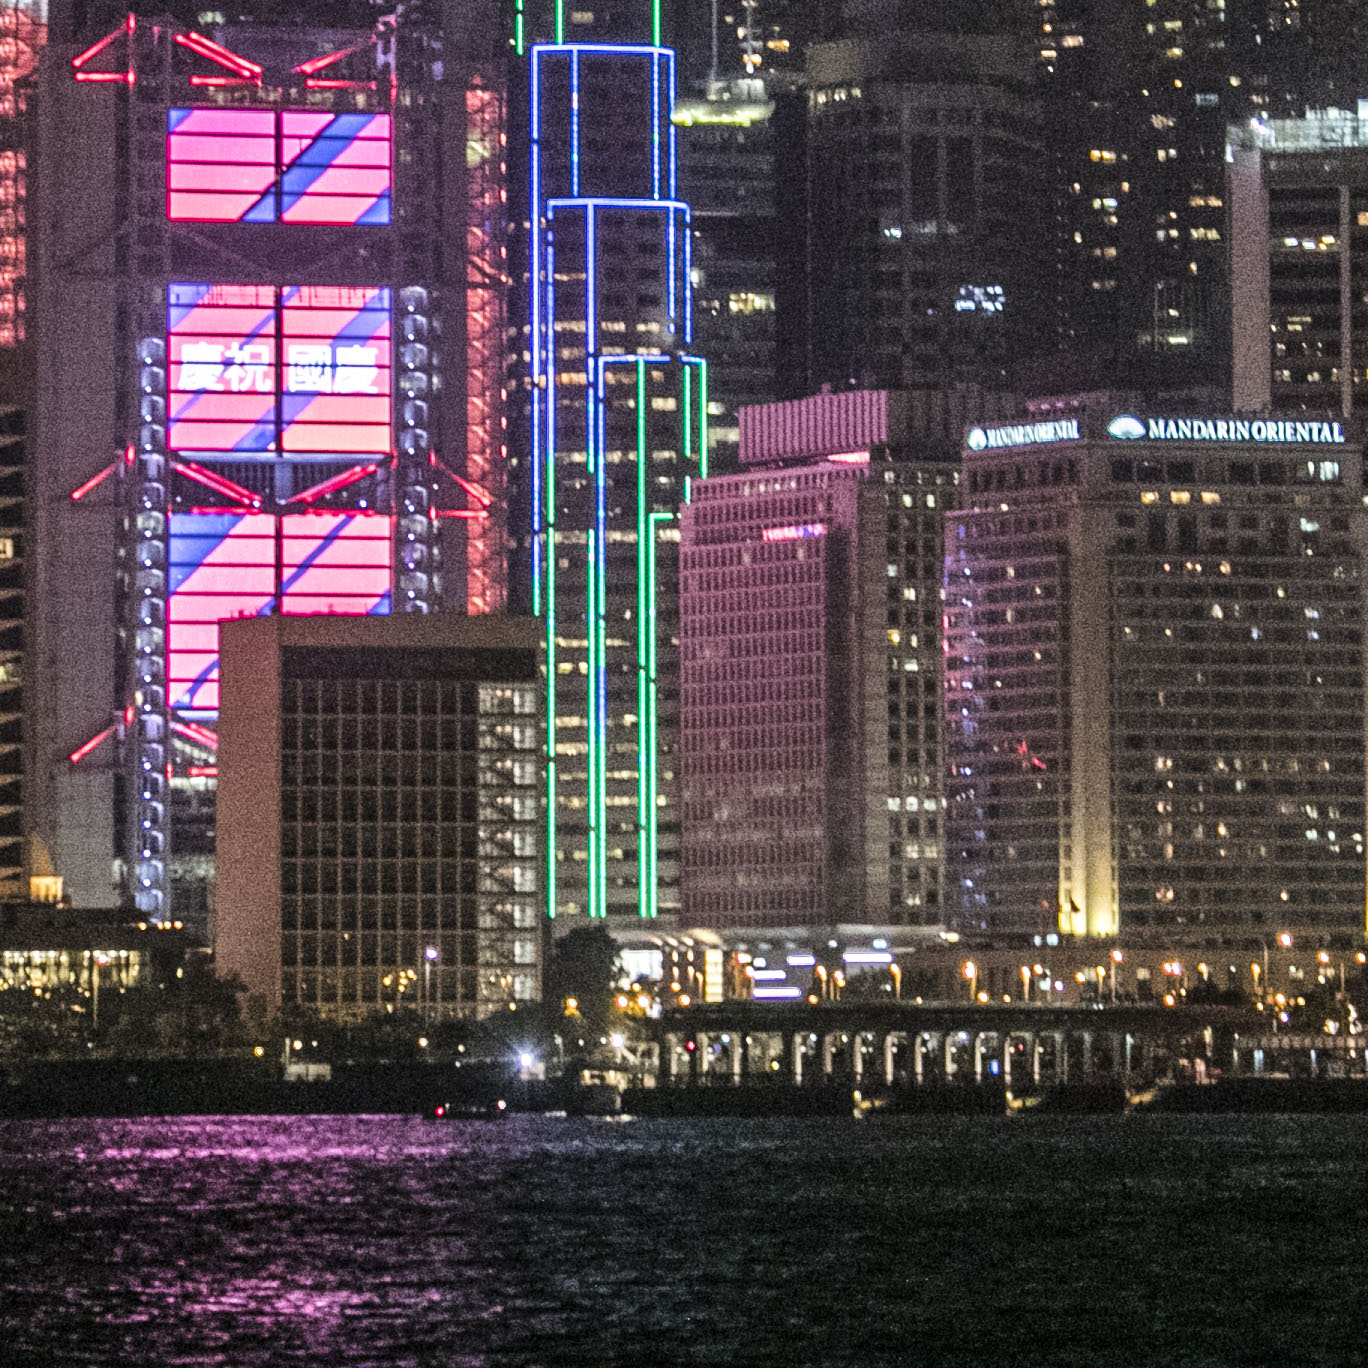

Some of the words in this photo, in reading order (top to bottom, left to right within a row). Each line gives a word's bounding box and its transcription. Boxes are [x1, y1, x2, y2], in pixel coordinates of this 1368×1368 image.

[178, 342, 379, 393] 慶祝國慶
[1148, 418, 1250, 441] MANDARIN
[1251, 420, 1345, 443] ORIENTAL
